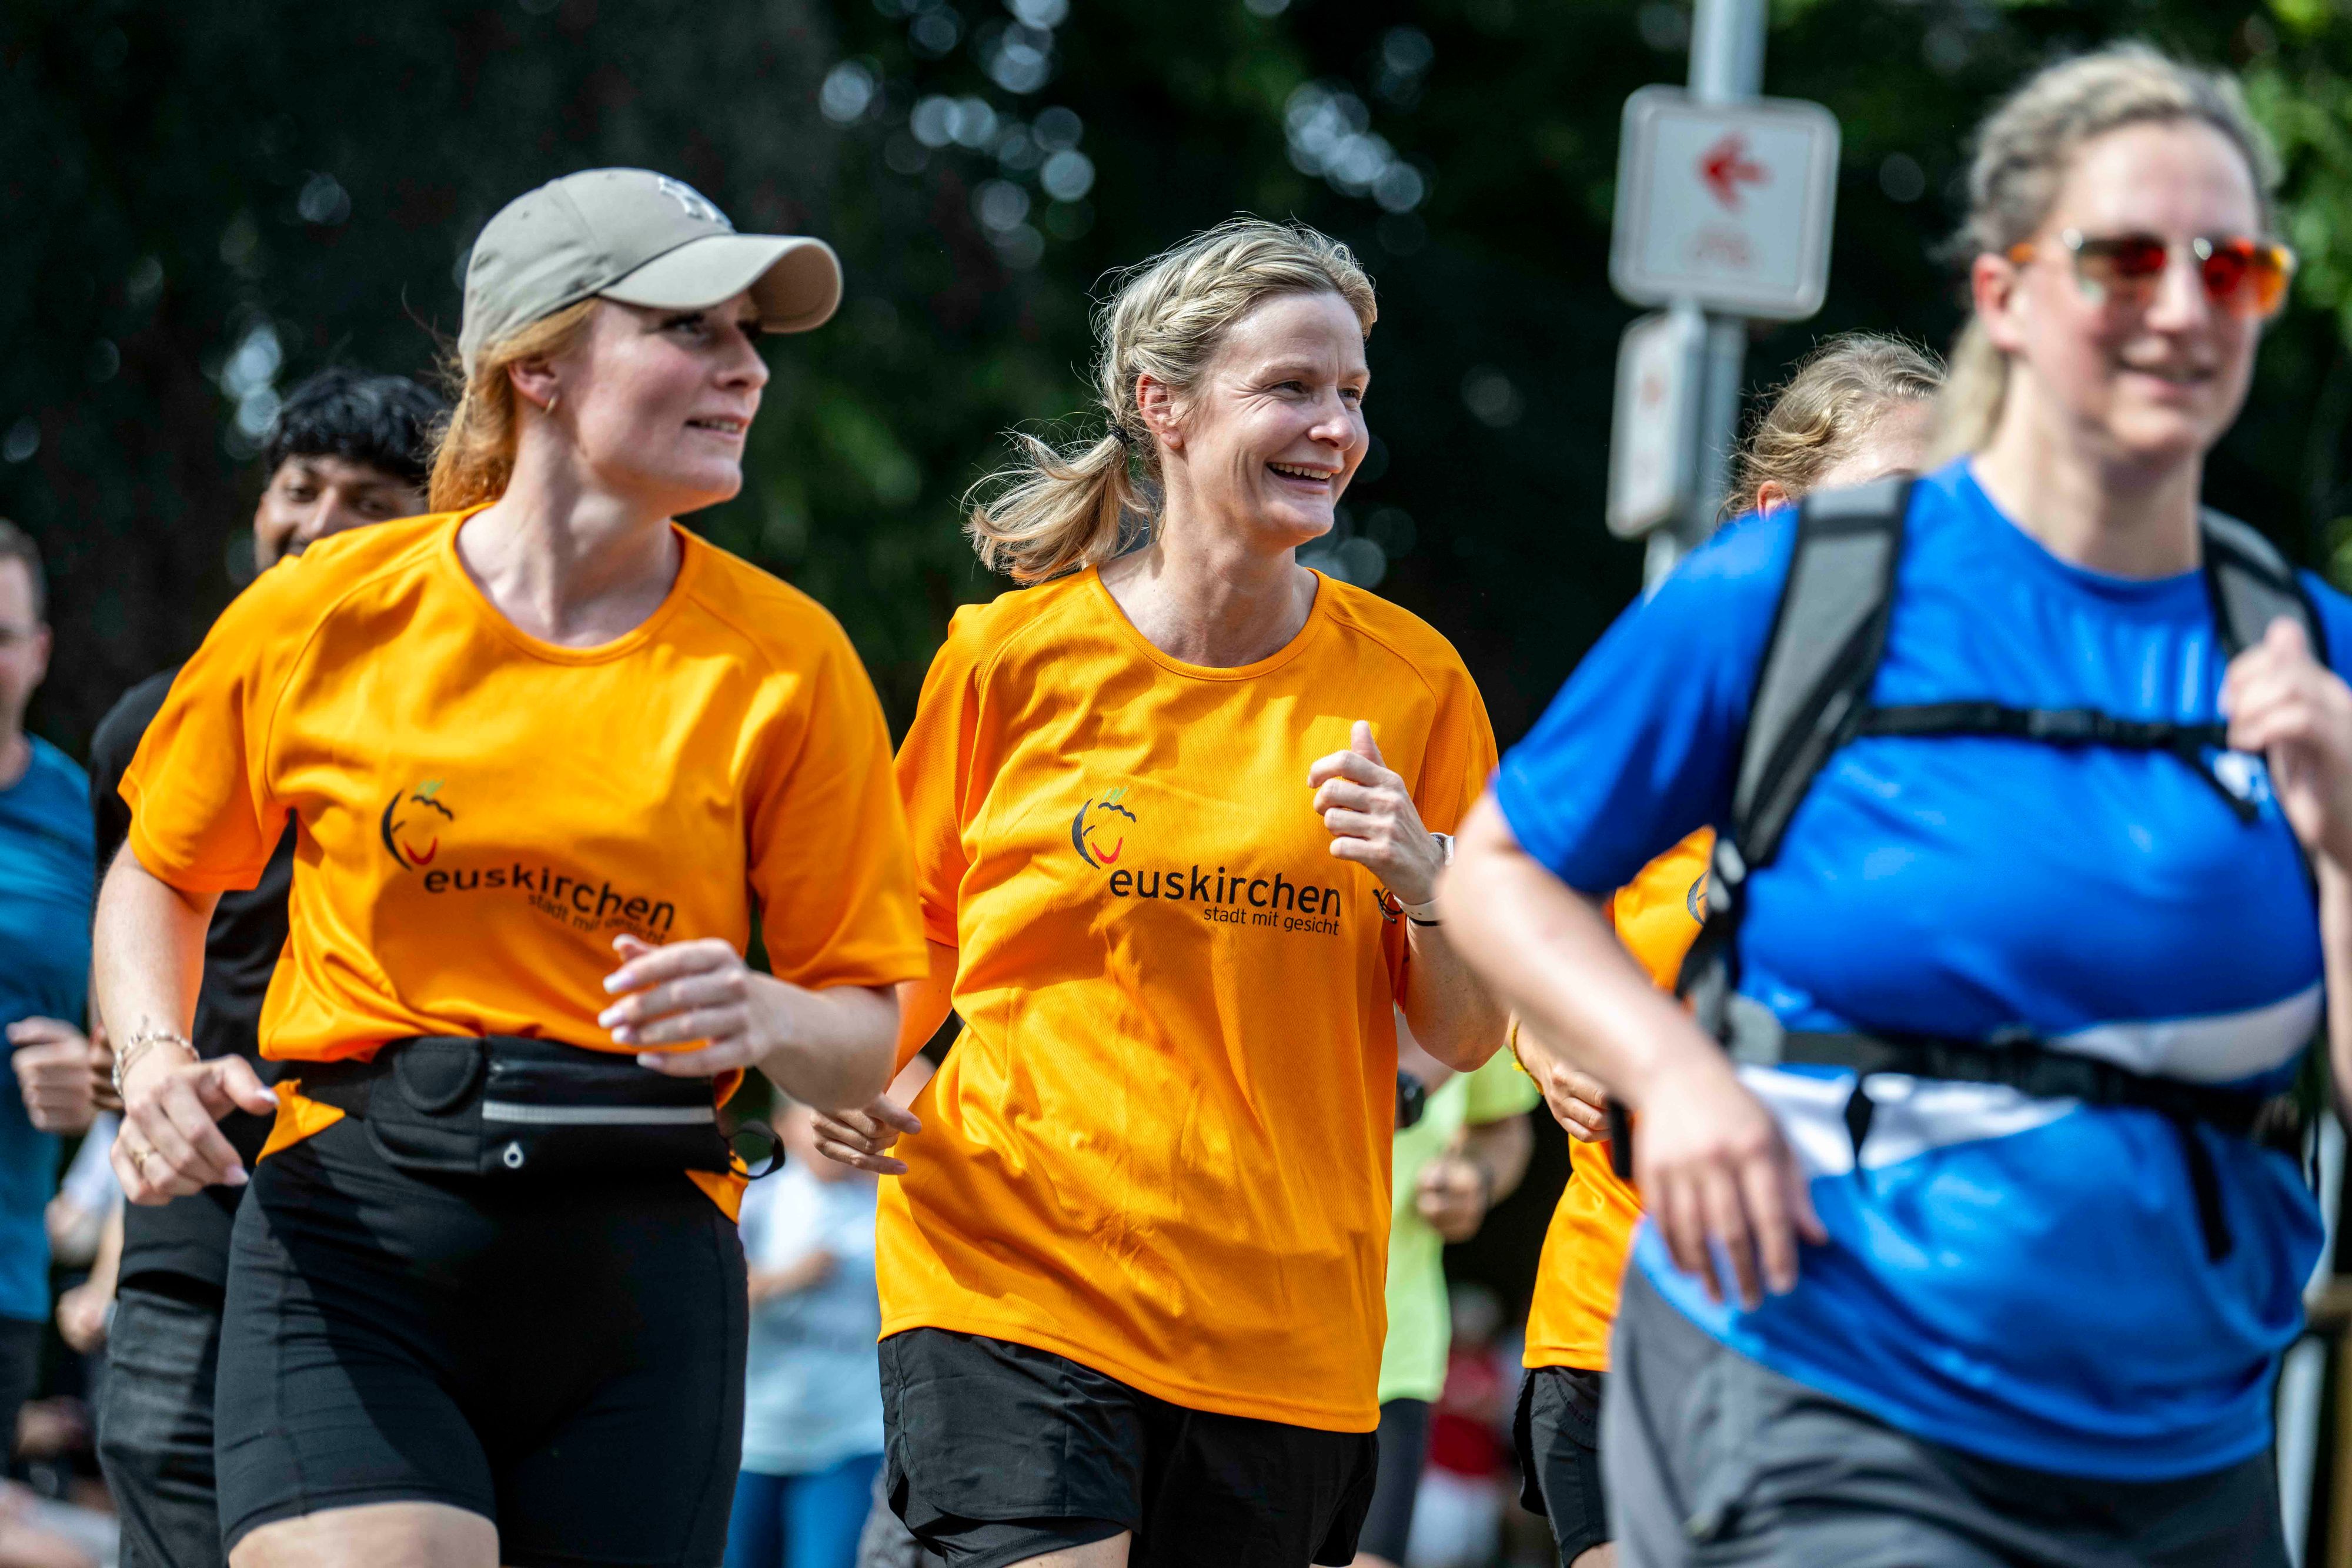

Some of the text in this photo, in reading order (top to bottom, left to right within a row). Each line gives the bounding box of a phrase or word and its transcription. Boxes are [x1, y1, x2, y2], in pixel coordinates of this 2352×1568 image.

[424, 863, 675, 931] euskirchen
[528, 894, 568, 922] stadt
[1110, 865, 1341, 917] euskirchen
[1204, 906, 1340, 936] stadt mit gesicht
